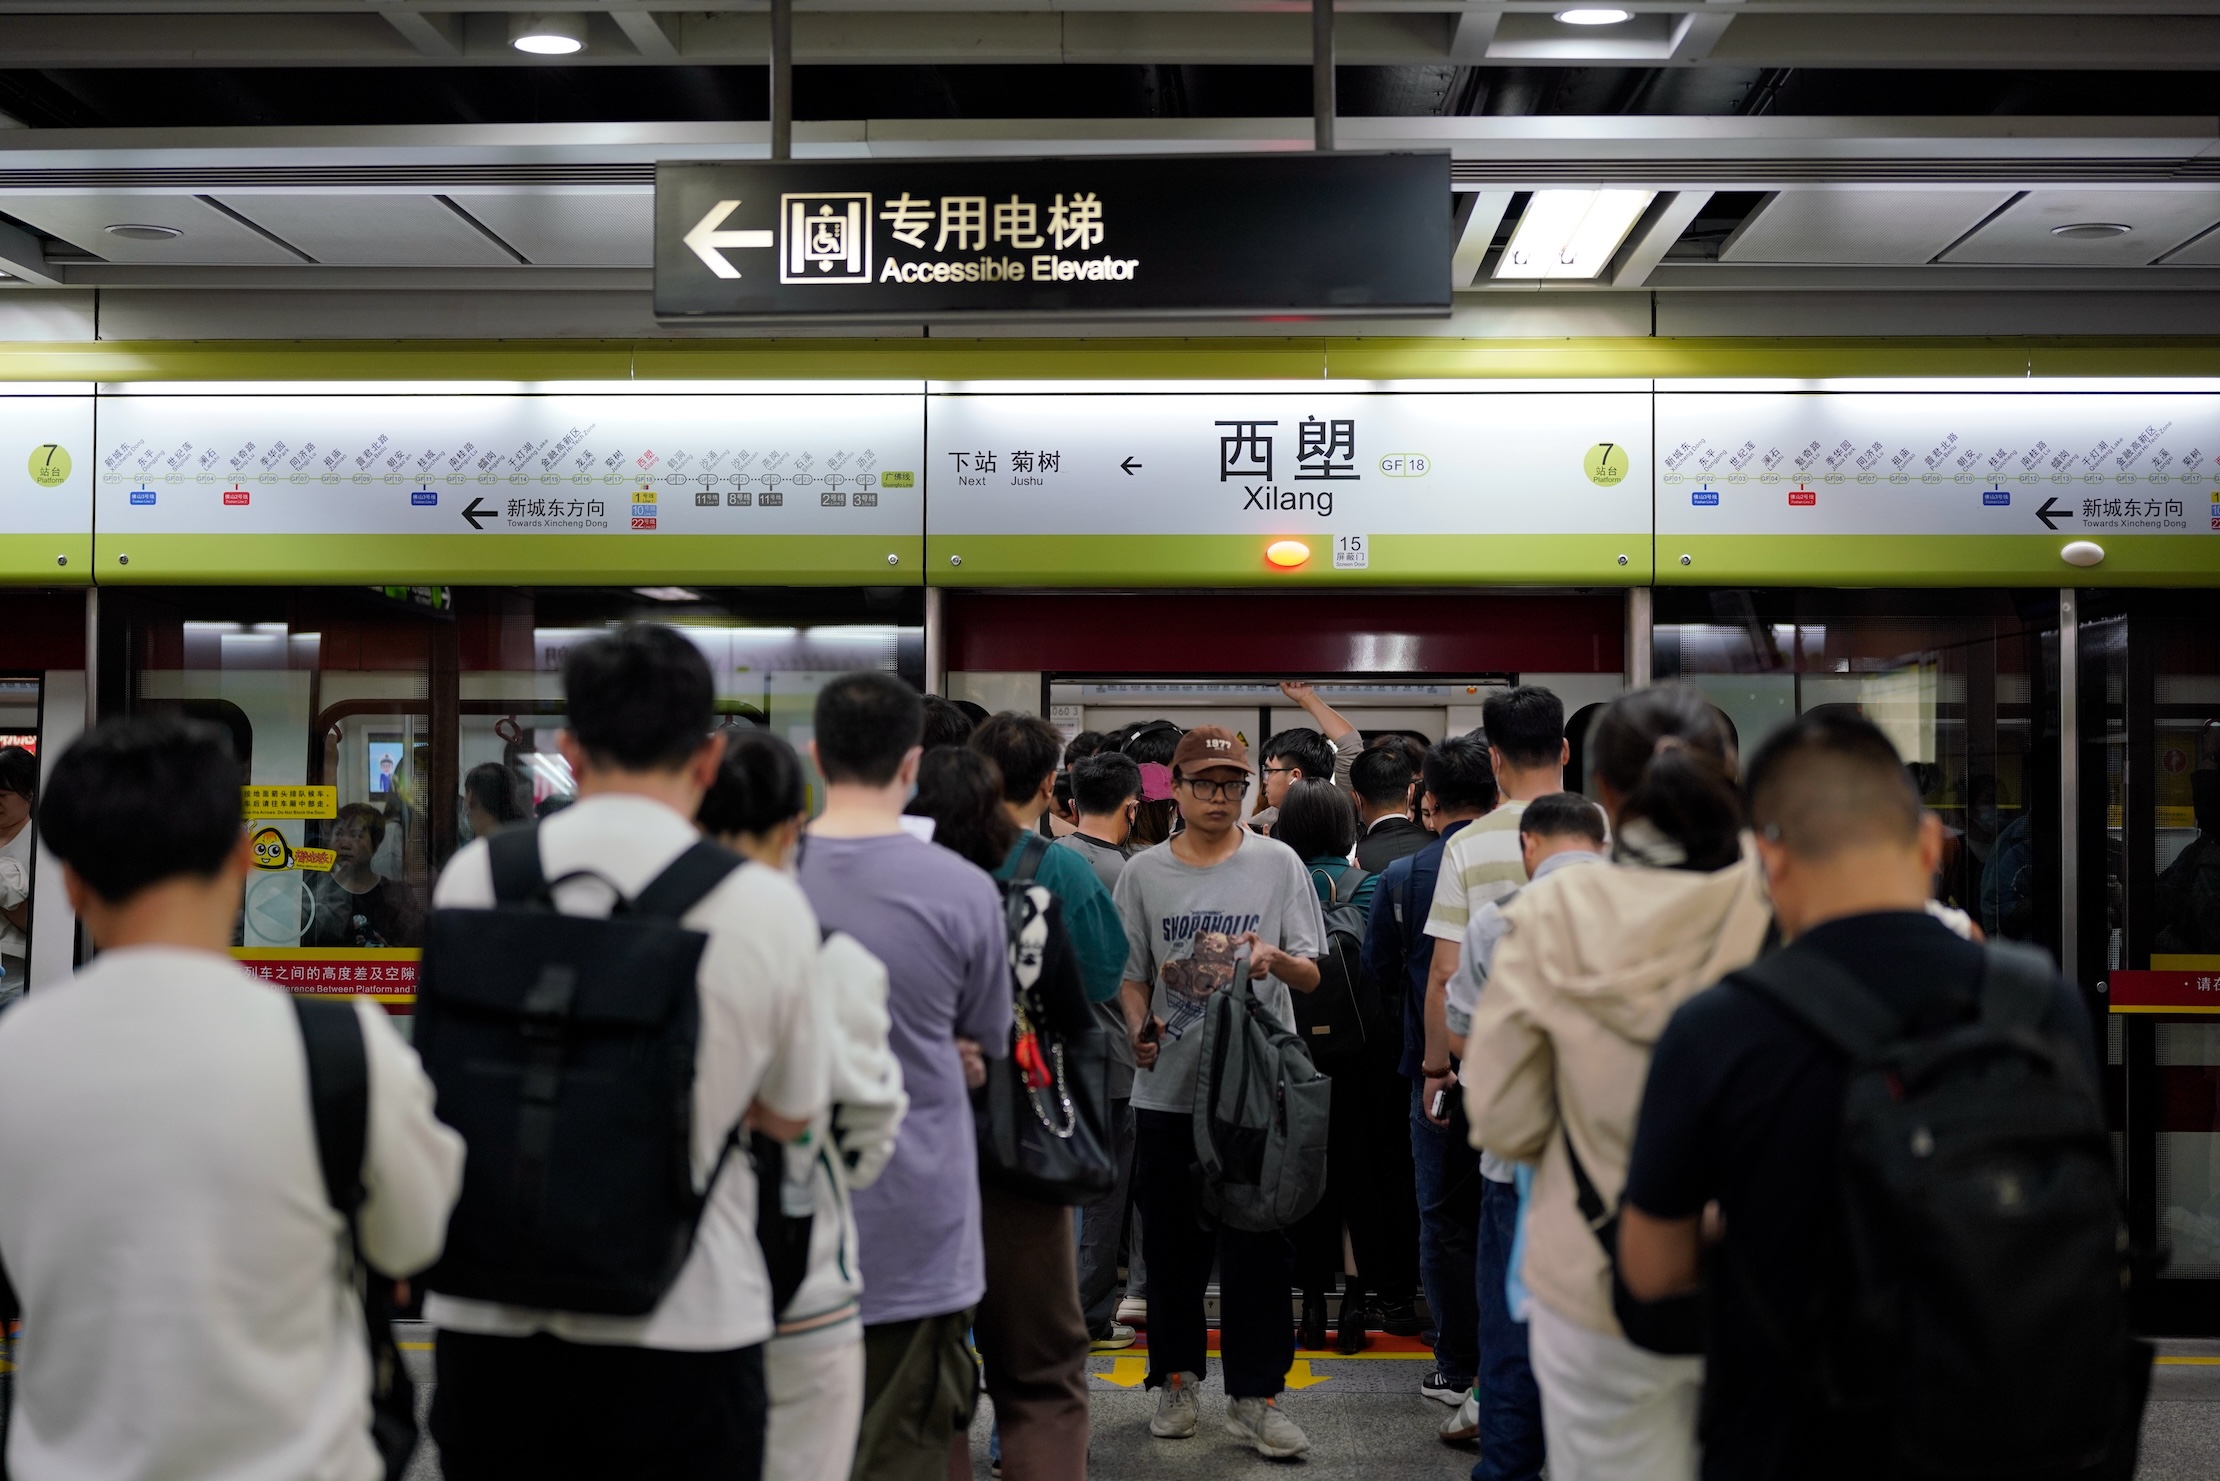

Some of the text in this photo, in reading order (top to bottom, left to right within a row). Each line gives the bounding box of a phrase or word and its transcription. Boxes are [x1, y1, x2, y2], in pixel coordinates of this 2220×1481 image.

[879, 191, 1104, 252] 专用电梯
[879, 255, 1139, 283] Accessible Elevator
[104, 442, 129, 466] 新城东
[260, 440, 285, 465] 季华园
[355, 434, 388, 466] 普君北路
[448, 442, 474, 467] 南桂路
[508, 442, 533, 466] 千灯湖
[541, 427, 580, 468] 金融高新区
[1214, 415, 1360, 482] 西塱
[1599, 444, 1614, 465] 7
[1664, 442, 1690, 466] 新城东
[1826, 440, 1851, 465] 季华园
[1856, 441, 1882, 467] 同济路
[1924, 432, 1957, 465] 普君北路
[2020, 440, 2046, 466] 南桂路
[2082, 440, 2108, 464] 千灯湖
[2116, 425, 2156, 466] 金融高新区
[44, 445, 58, 466] 7
[137, 449, 152, 466] 东平
[289, 442, 315, 468] 同济路
[323, 448, 341, 466] 祖庙
[387, 450, 404, 466] 朝安
[417, 449, 435, 467] 桂城
[575, 449, 592, 468] 龙溪
[605, 450, 623, 467] 菊树
[699, 450, 717, 468] 沙涌
[731, 449, 749, 468] 沙园
[794, 451, 812, 468] 石溪
[826, 450, 845, 468] 南洲
[948, 451, 1060, 474] 下站 菊树
[1698, 448, 1714, 466] 东平
[1891, 448, 1909, 465] 祖庙
[1957, 449, 1975, 466] 朝安
[1988, 448, 2006, 466] 桂城
[2152, 448, 2169, 466] 龙溪
[2182, 448, 2200, 466] 菊树
[40, 467, 60, 477] 站台
[1382, 459, 1424, 472] GF 18
[1596, 466, 1618, 476] 站台
[959, 477, 1043, 486] Next Jushu
[508, 499, 604, 516] 新城东方向
[1243, 485, 1333, 516] Xilang
[2082, 499, 2182, 516] 新城东方向
[544, 520, 583, 528] Xincheng
[586, 520, 608, 528] Dong
[2120, 520, 2161, 528] Xincheng
[2164, 520, 2186, 528] Dong
[1340, 536, 1360, 550] 15
[1337, 552, 1364, 560] 屏蔽门
[1206, 739, 1232, 749] 1977
[317, 985, 353, 993] Between
[356, 985, 392, 994] Platform
[394, 986, 410, 994] and
